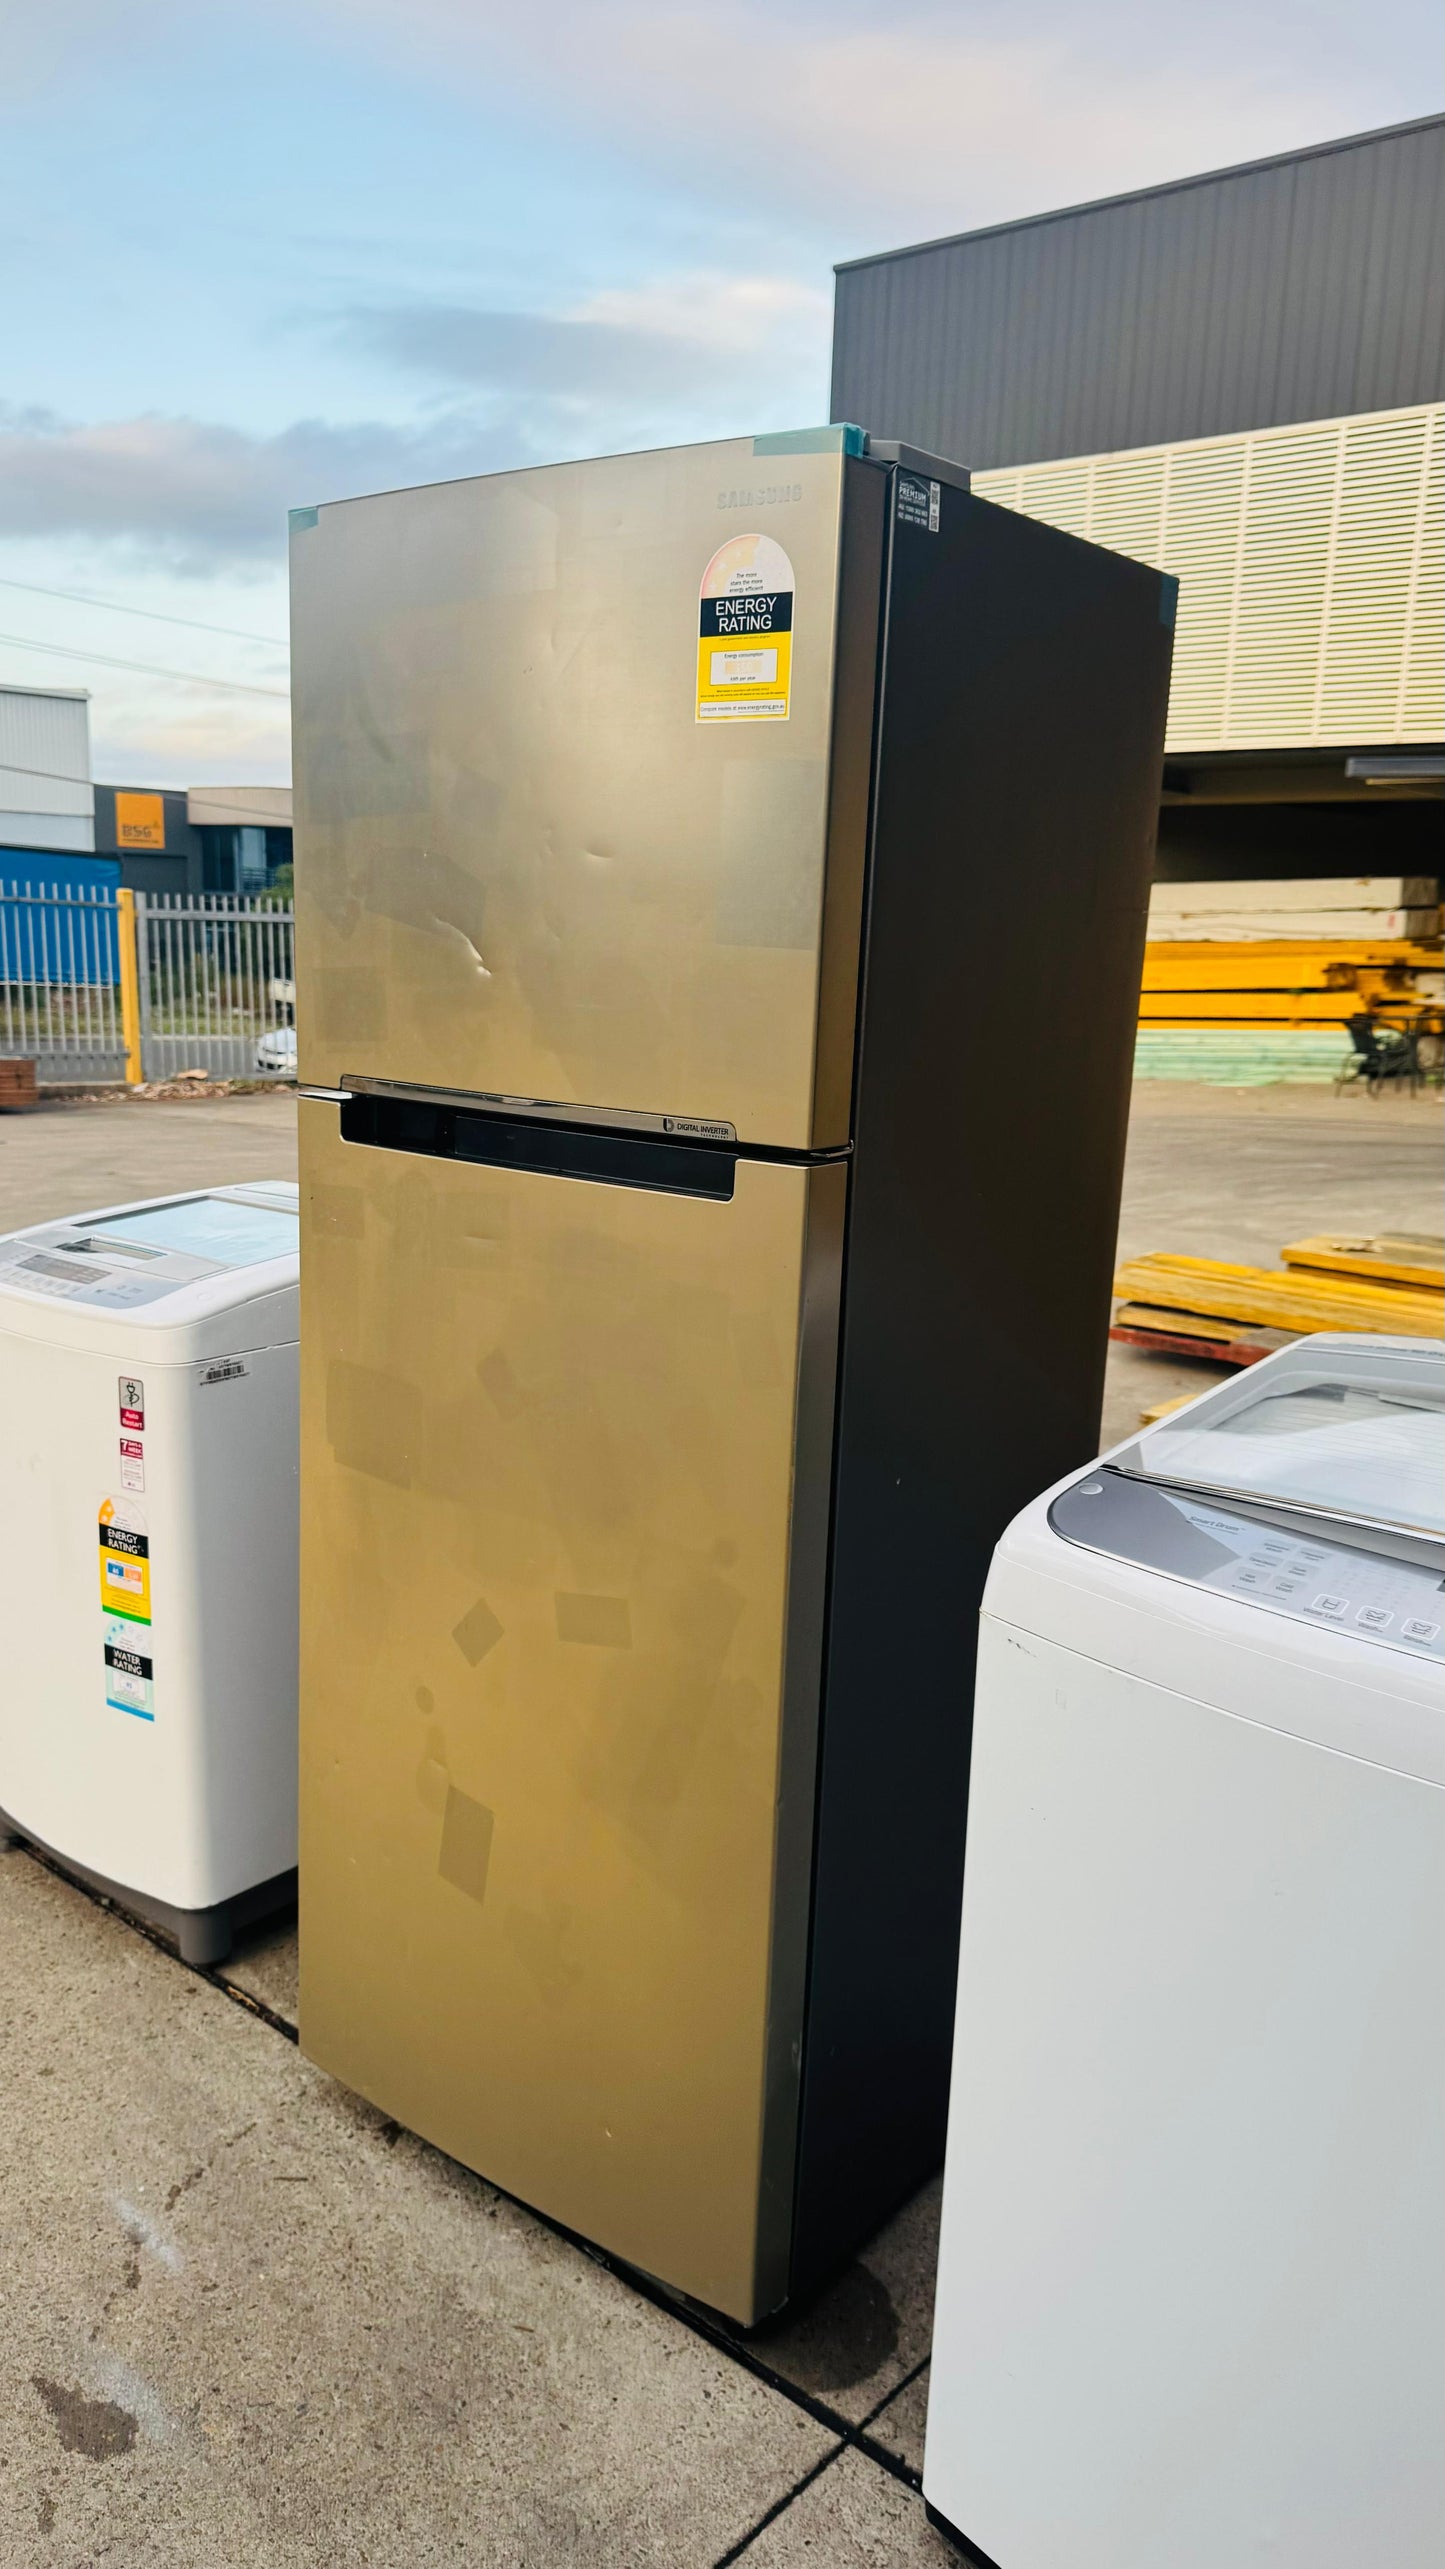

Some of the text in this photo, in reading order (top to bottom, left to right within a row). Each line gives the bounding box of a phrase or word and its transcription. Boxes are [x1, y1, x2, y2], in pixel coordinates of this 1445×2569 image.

[716, 596, 777, 616] ENERGY
[719, 614, 772, 632] RATING
[677, 1123, 729, 1135] DIGITAL INVERTER
[107, 1528, 138, 1544] ENERGY
[108, 1539, 138, 1554] RATING
[113, 1649, 140, 1665] WATER
[112, 1658, 142, 1676] RATING
